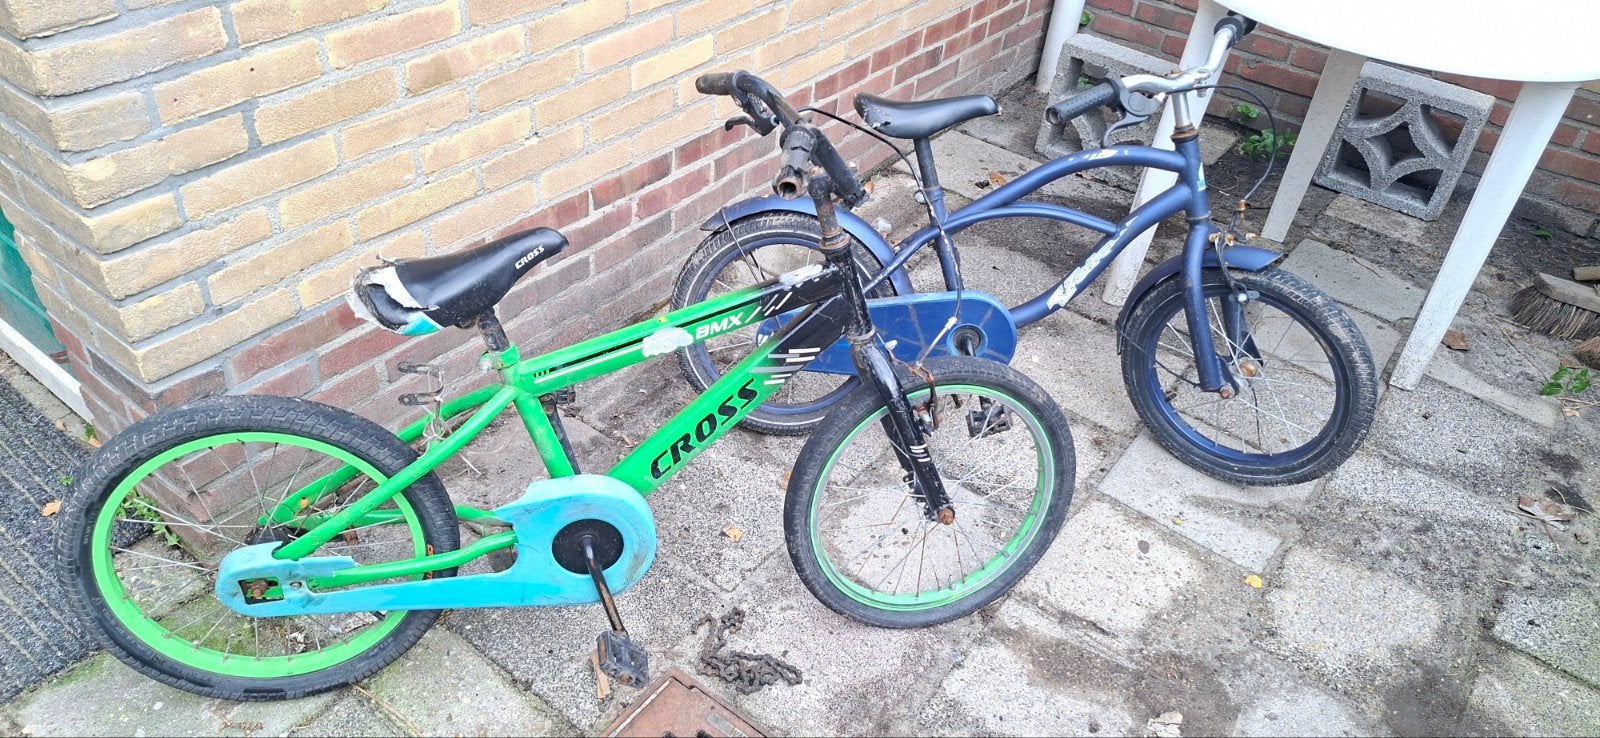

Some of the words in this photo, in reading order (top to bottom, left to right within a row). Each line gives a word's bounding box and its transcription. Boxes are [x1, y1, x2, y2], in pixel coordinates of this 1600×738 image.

[514, 244, 545, 270] CROSS
[695, 312, 744, 340] BMX
[650, 378, 759, 480] CROSS
